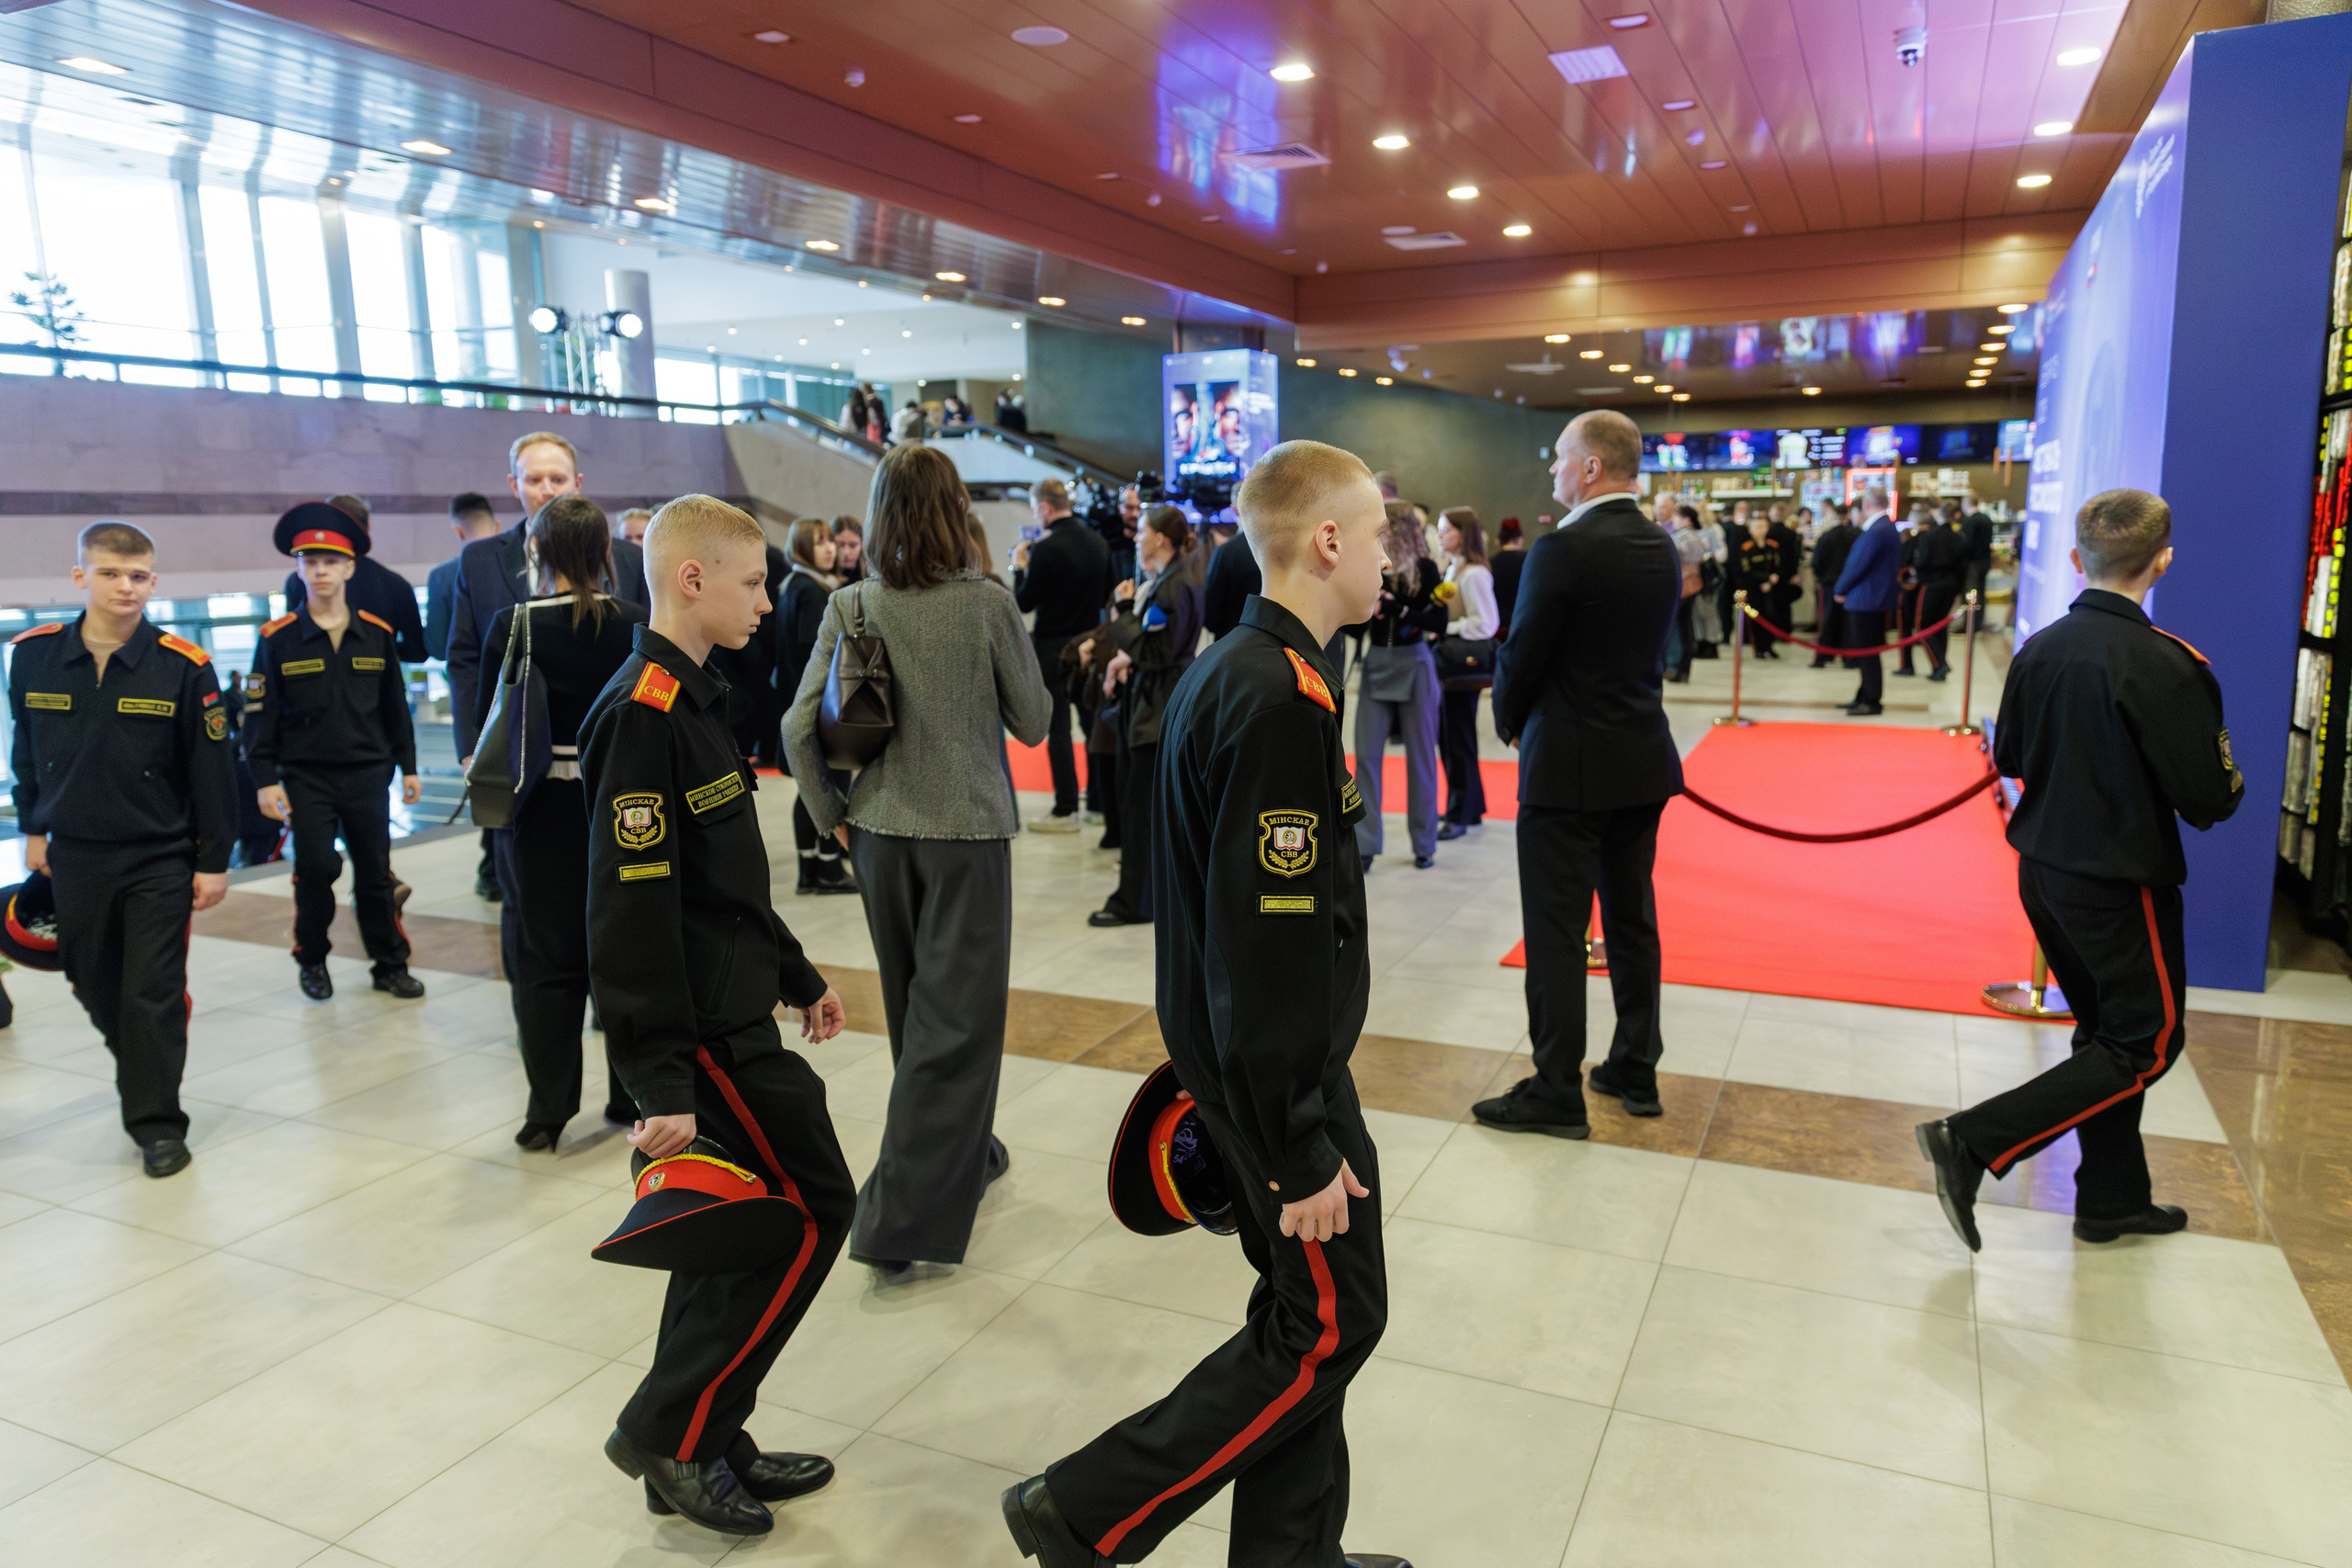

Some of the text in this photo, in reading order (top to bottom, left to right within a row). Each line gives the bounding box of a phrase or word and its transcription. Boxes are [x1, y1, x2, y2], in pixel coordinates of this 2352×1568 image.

[643, 685, 670, 702] СВВ
[1306, 676, 1328, 698] СВВ
[619, 798, 655, 808] МІНСКАЕ
[1269, 816, 1310, 826] МІНСКАЕ
